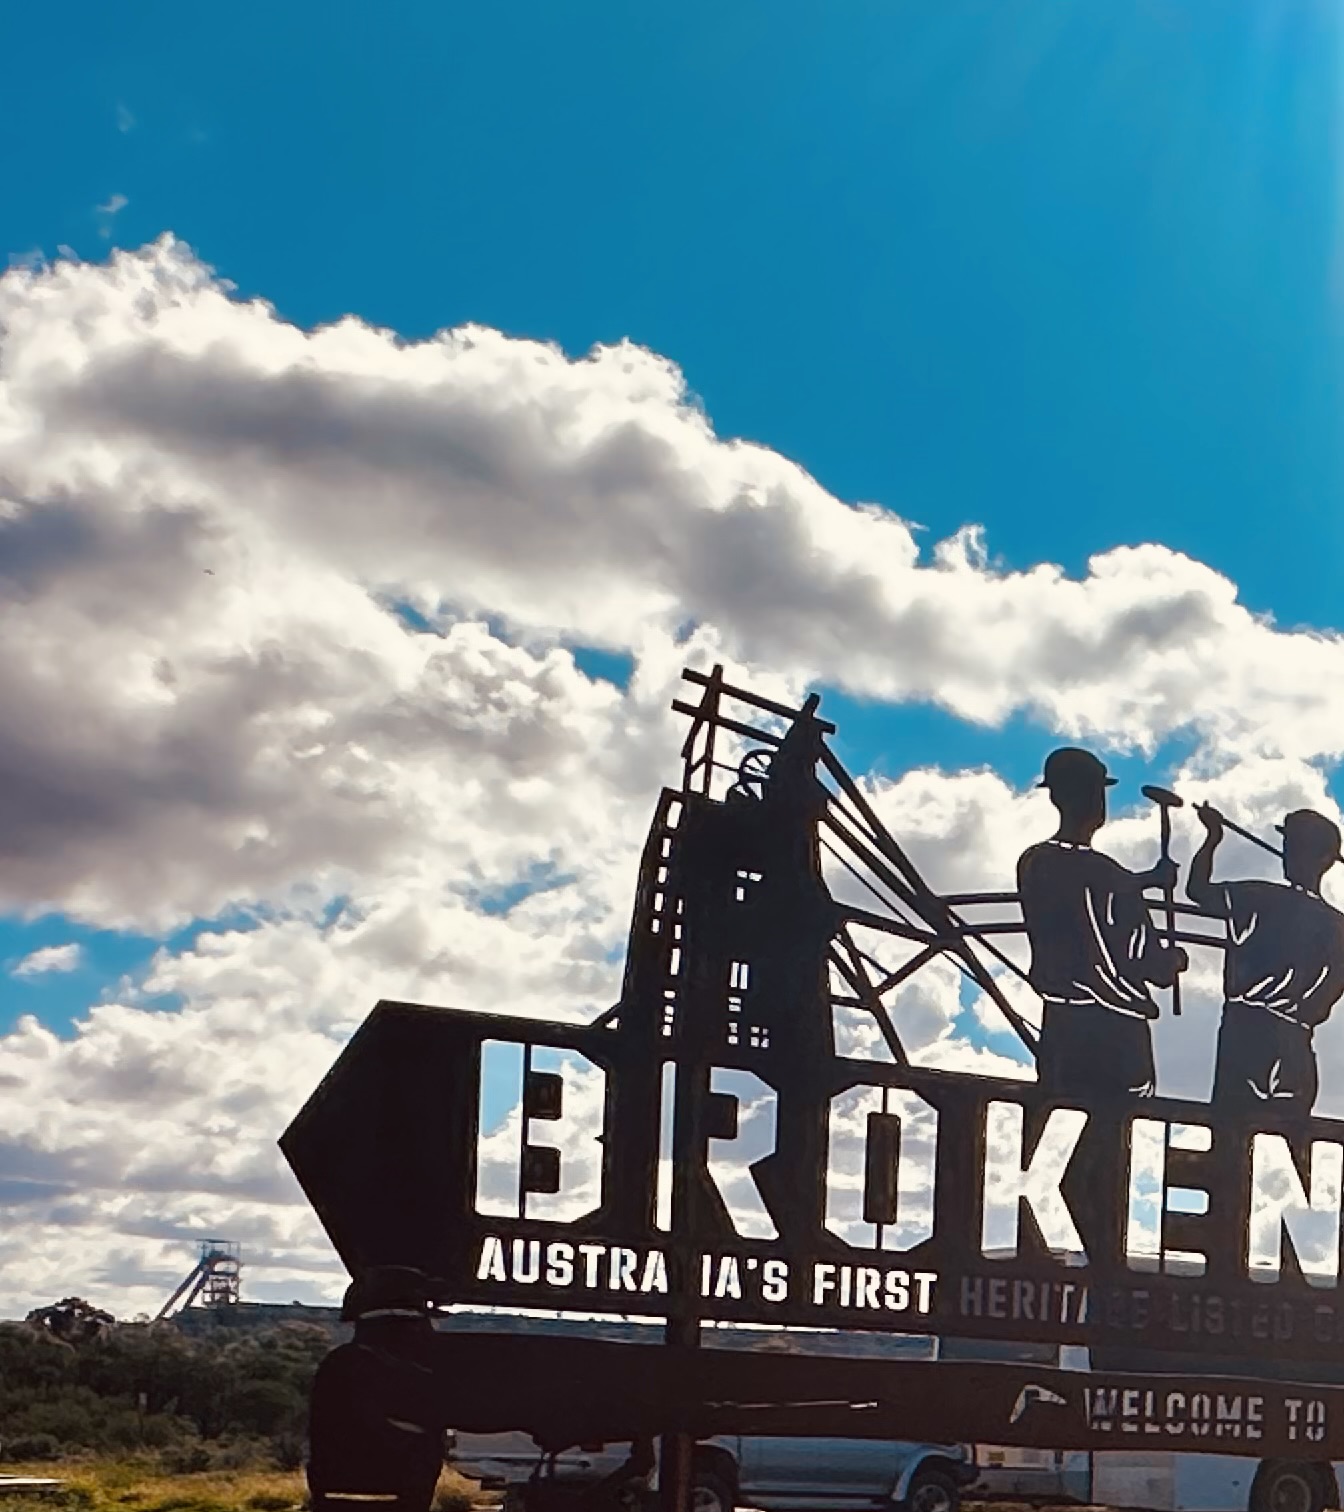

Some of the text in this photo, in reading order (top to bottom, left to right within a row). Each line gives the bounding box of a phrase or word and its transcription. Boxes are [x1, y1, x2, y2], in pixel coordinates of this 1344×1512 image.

[475, 1039, 1344, 1287] BROKEN
[477, 1237, 788, 1302] AUSTRAIA'S
[813, 1261, 938, 1314] FIRST
[1084, 1387, 1263, 1439] WELCOME
[1284, 1399, 1326, 1441] TO
